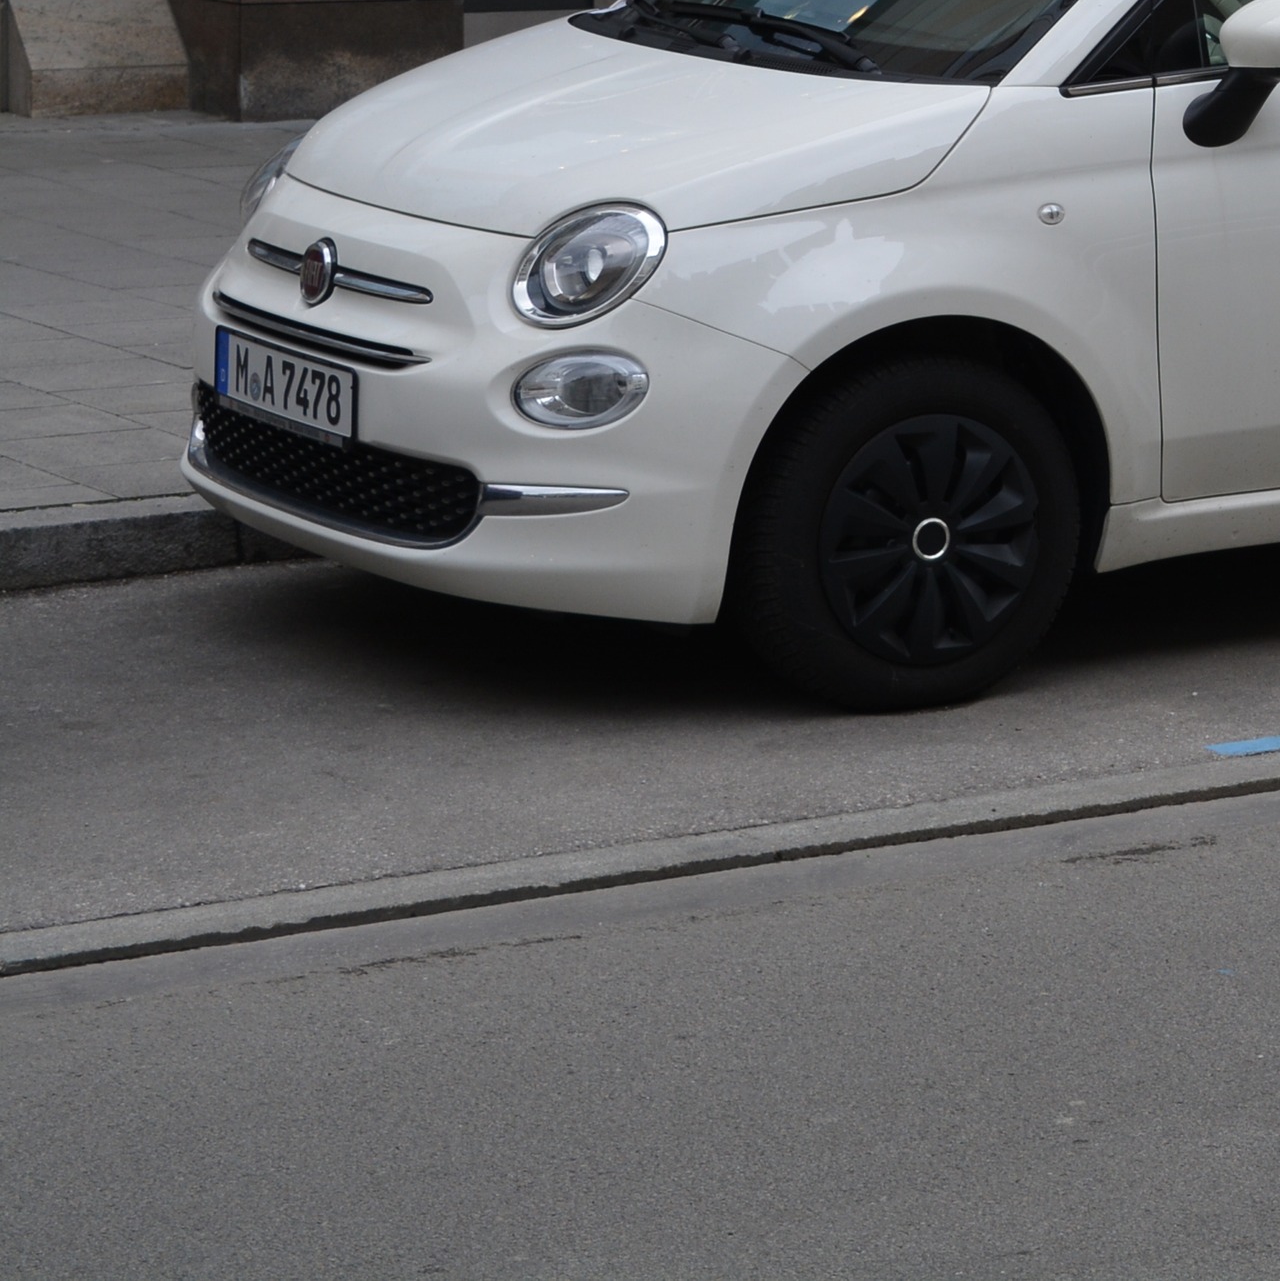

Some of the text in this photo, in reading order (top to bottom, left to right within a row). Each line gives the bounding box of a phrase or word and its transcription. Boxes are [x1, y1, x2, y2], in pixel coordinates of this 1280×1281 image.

[235, 343, 250, 397] M
[261, 354, 276, 407] A
[281, 359, 342, 427] 7478
